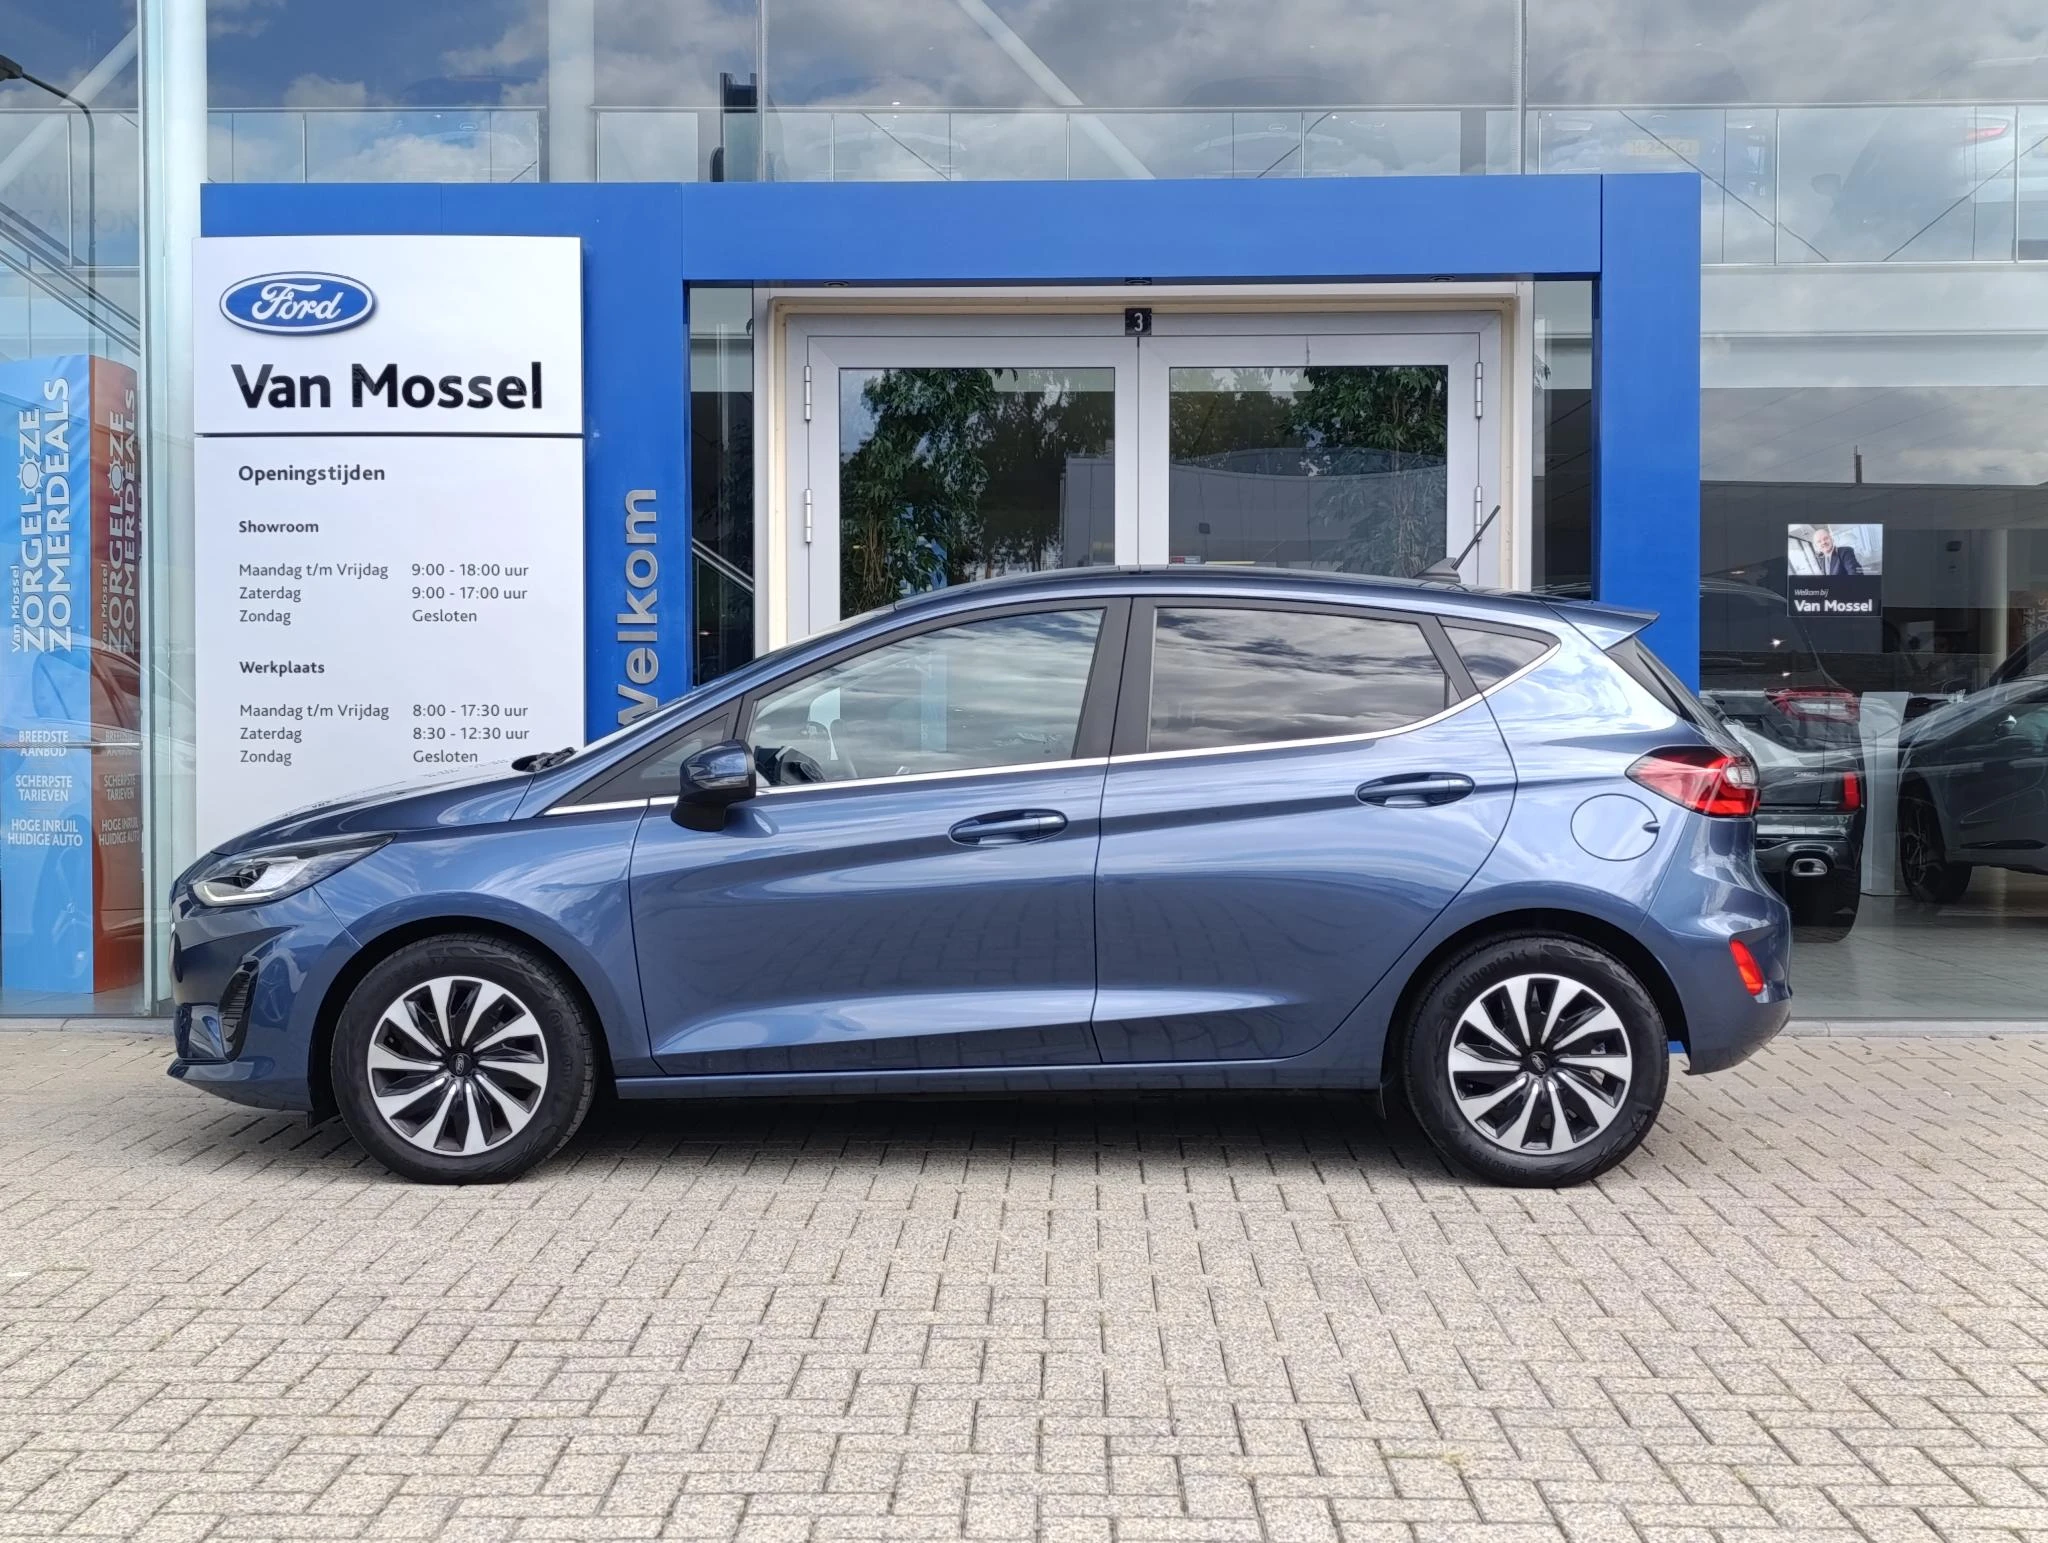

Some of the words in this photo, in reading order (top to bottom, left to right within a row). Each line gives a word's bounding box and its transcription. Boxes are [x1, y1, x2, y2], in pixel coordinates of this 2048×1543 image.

[251, 281, 344, 320] Ford
[1134, 312, 1143, 332] 3
[231, 363, 331, 409] Van
[352, 361, 543, 410] Mossel
[238, 464, 386, 487] Openingstijden
[44, 377, 71, 653] ZOMERDEALS
[123, 388, 135, 656] ZOMERDEALS
[238, 520, 320, 534] Showroom
[239, 562, 303, 578] Maandag
[305, 562, 333, 577] t/m
[336, 562, 389, 580] Vrijdag
[411, 563, 445, 577] 9:00
[459, 563, 501, 577] 18:00
[504, 566, 529, 577] uur
[10, 565, 20, 619] Mossel
[239, 585, 302, 603] Zaterdag
[411, 586, 446, 600] 9:00
[459, 586, 500, 600] 17:00
[503, 589, 528, 600] uur
[1794, 600, 1820, 612] Van
[1824, 599, 1873, 612] Mossel
[239, 608, 292, 626] Zondag
[411, 608, 478, 623] Gesloten
[11, 624, 20, 653] Van
[238, 660, 326, 677] Werkplaats
[239, 703, 304, 720] Maandag
[306, 703, 334, 718] t/m
[337, 703, 390, 721] Vrijdag
[412, 703, 446, 717] 8:00
[460, 703, 500, 717] 17:30
[504, 707, 529, 717] uur
[18, 730, 69, 743] BREEDSTE
[239, 726, 303, 744] Zaterdag
[412, 726, 446, 740] 8:30
[459, 726, 502, 740] 12:30
[505, 729, 530, 740] uur
[239, 749, 293, 767] Zondag
[412, 749, 478, 763] Gesloten
[15, 775, 73, 788] SCHERPSTE
[18, 788, 69, 802] TARIEVEN
[11, 819, 41, 832] HOGE
[42, 819, 79, 833] INRUIL
[7, 833, 51, 846] HUIDIGE
[52, 833, 83, 847] AUTO
